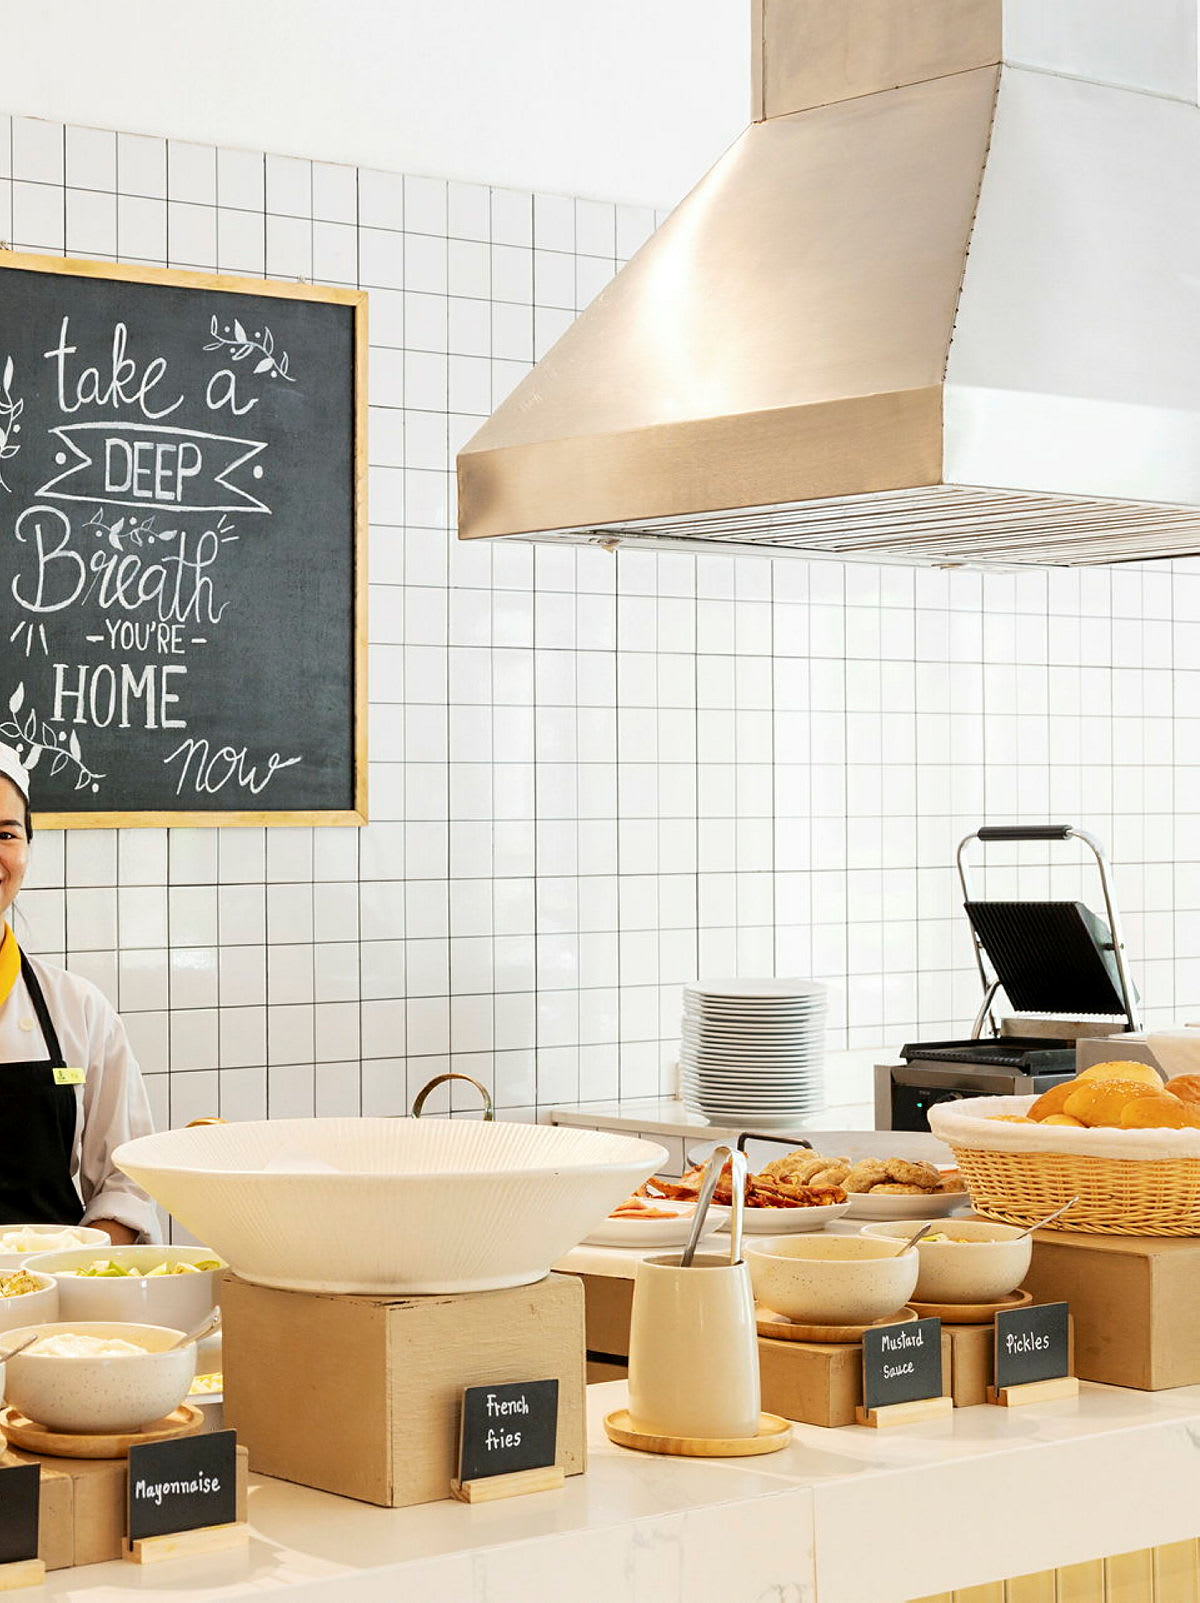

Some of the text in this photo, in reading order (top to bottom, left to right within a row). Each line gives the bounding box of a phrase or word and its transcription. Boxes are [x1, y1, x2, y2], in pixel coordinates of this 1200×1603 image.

[43, 316, 259, 419] take a
[105, 438, 202, 501] DEEP
[11, 505, 230, 623] Breath
[50, 663, 187, 729] HOME
[163, 738, 303, 795] now
[881, 1328, 924, 1352] Mustard
[1006, 1331, 1050, 1354] Pickles
[883, 1361, 915, 1379] Sauce
[486, 1393, 529, 1417] French
[485, 1427, 522, 1451] fries
[135, 1471, 221, 1506] Mayonnaise
